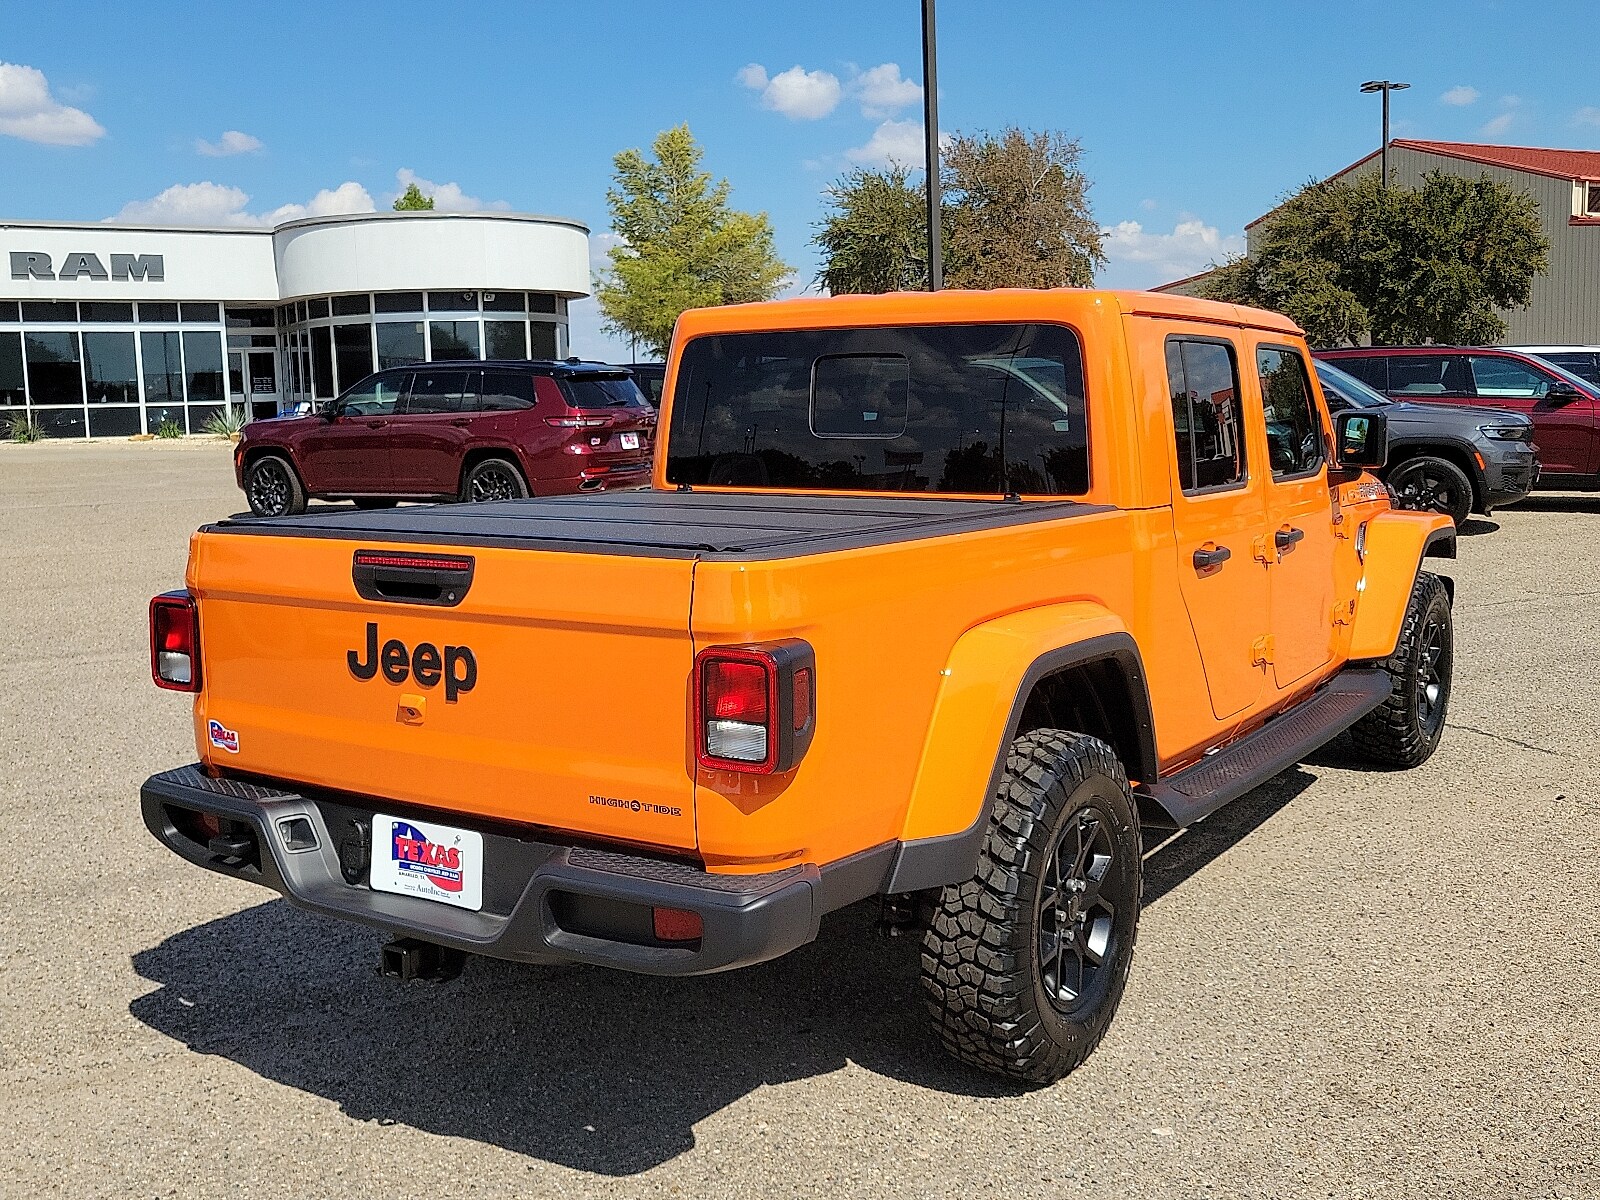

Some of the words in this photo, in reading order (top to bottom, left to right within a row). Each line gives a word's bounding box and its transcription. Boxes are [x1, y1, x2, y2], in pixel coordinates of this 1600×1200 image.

[9, 251, 165, 282] RAM
[347, 622, 478, 704] Jeep
[589, 795, 630, 809] HIGH
[641, 802, 682, 817] TIDE
[395, 836, 460, 870] TEXAS
